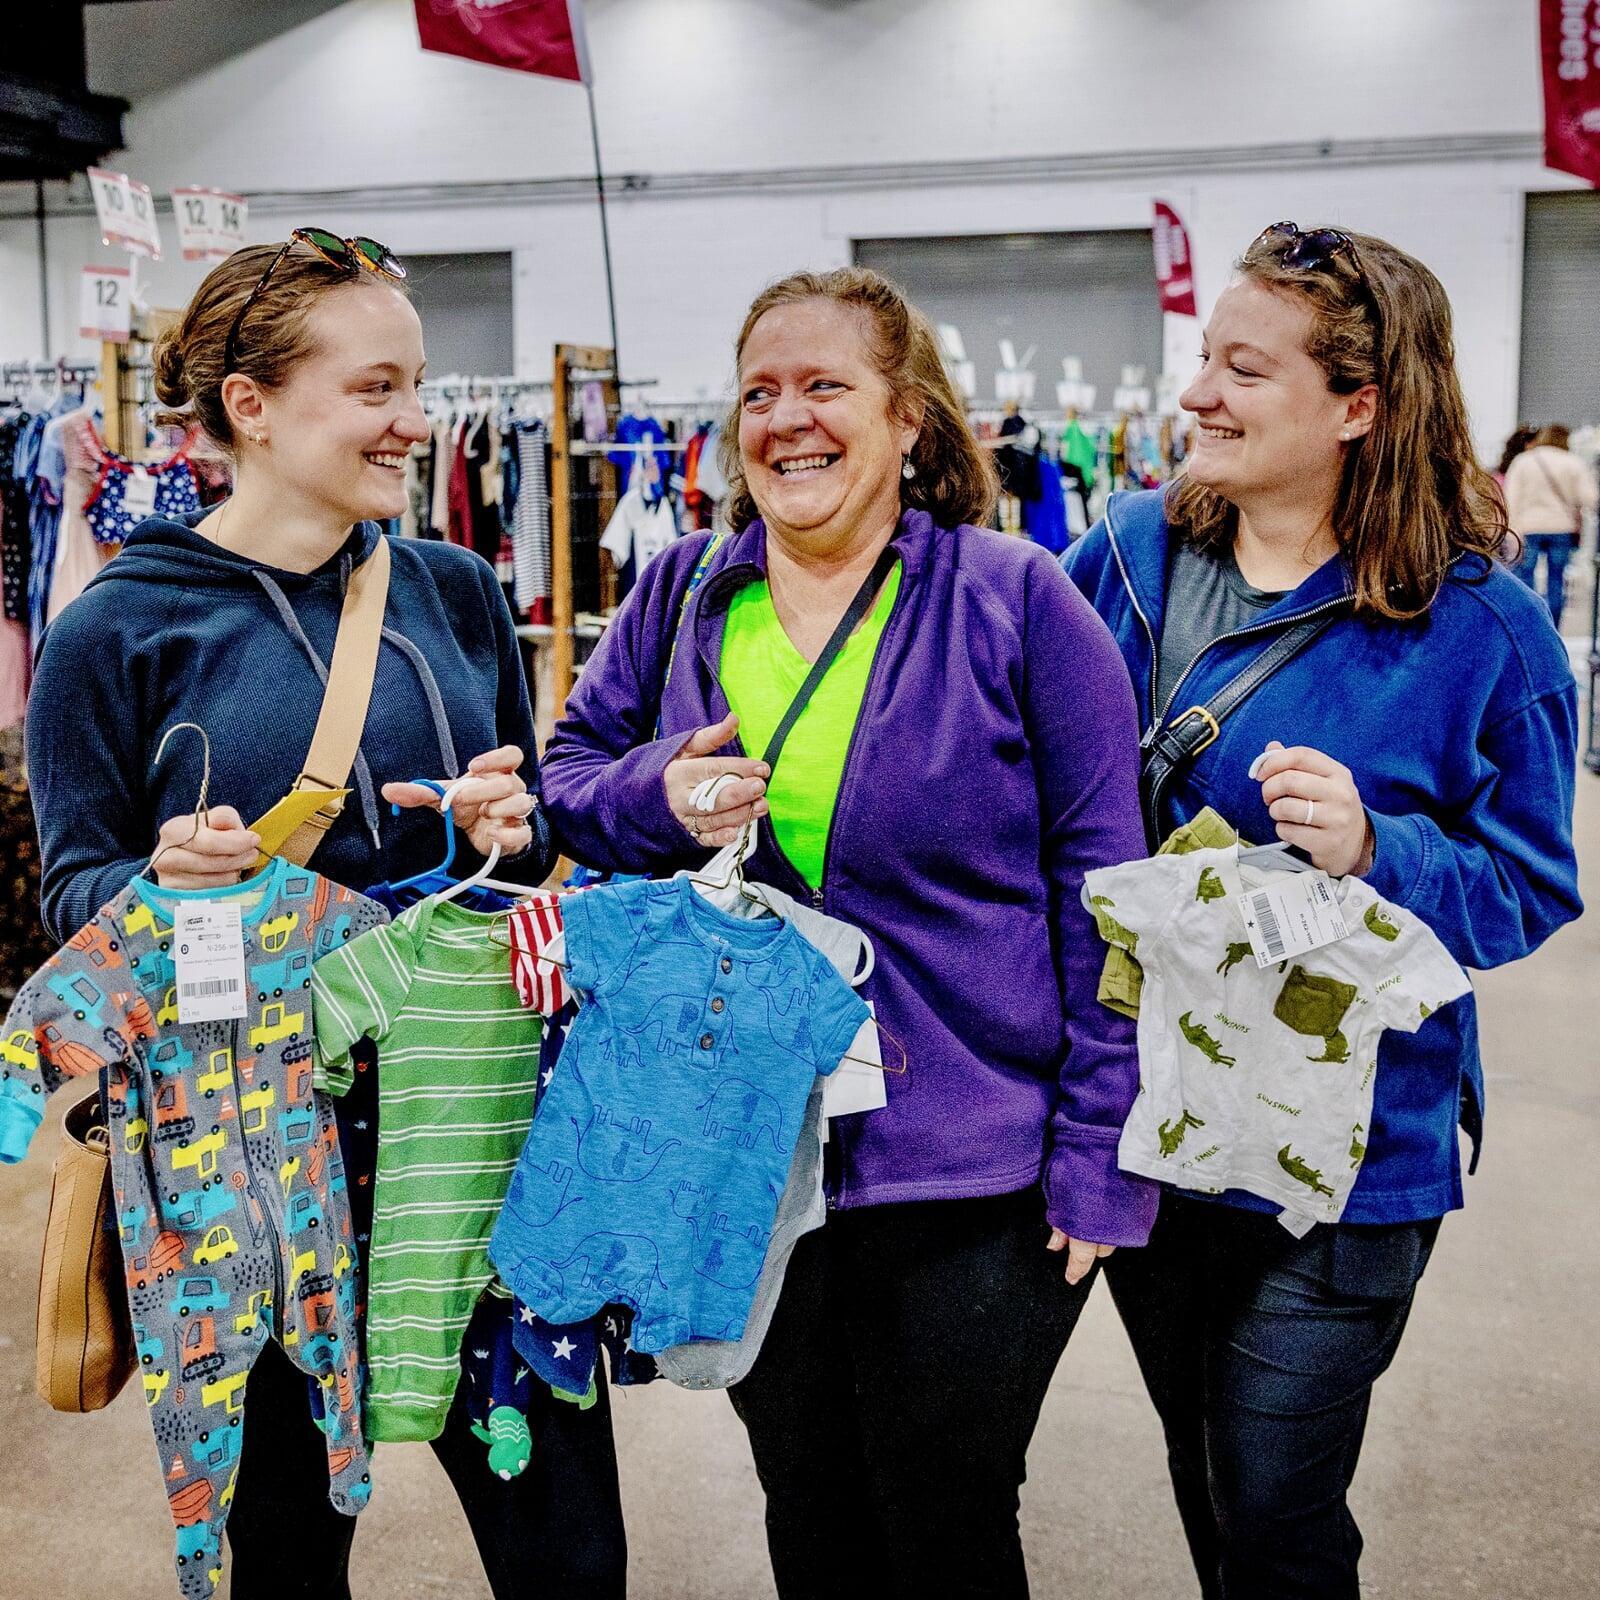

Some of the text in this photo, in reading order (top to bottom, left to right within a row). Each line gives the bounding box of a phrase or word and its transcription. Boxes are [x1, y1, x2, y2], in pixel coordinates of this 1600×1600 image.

[185, 199, 206, 226] 12
[95, 280, 119, 307] 12
[1256, 1092, 1301, 1117] SUNSHINE
[1194, 1144, 1221, 1163] SMILE
